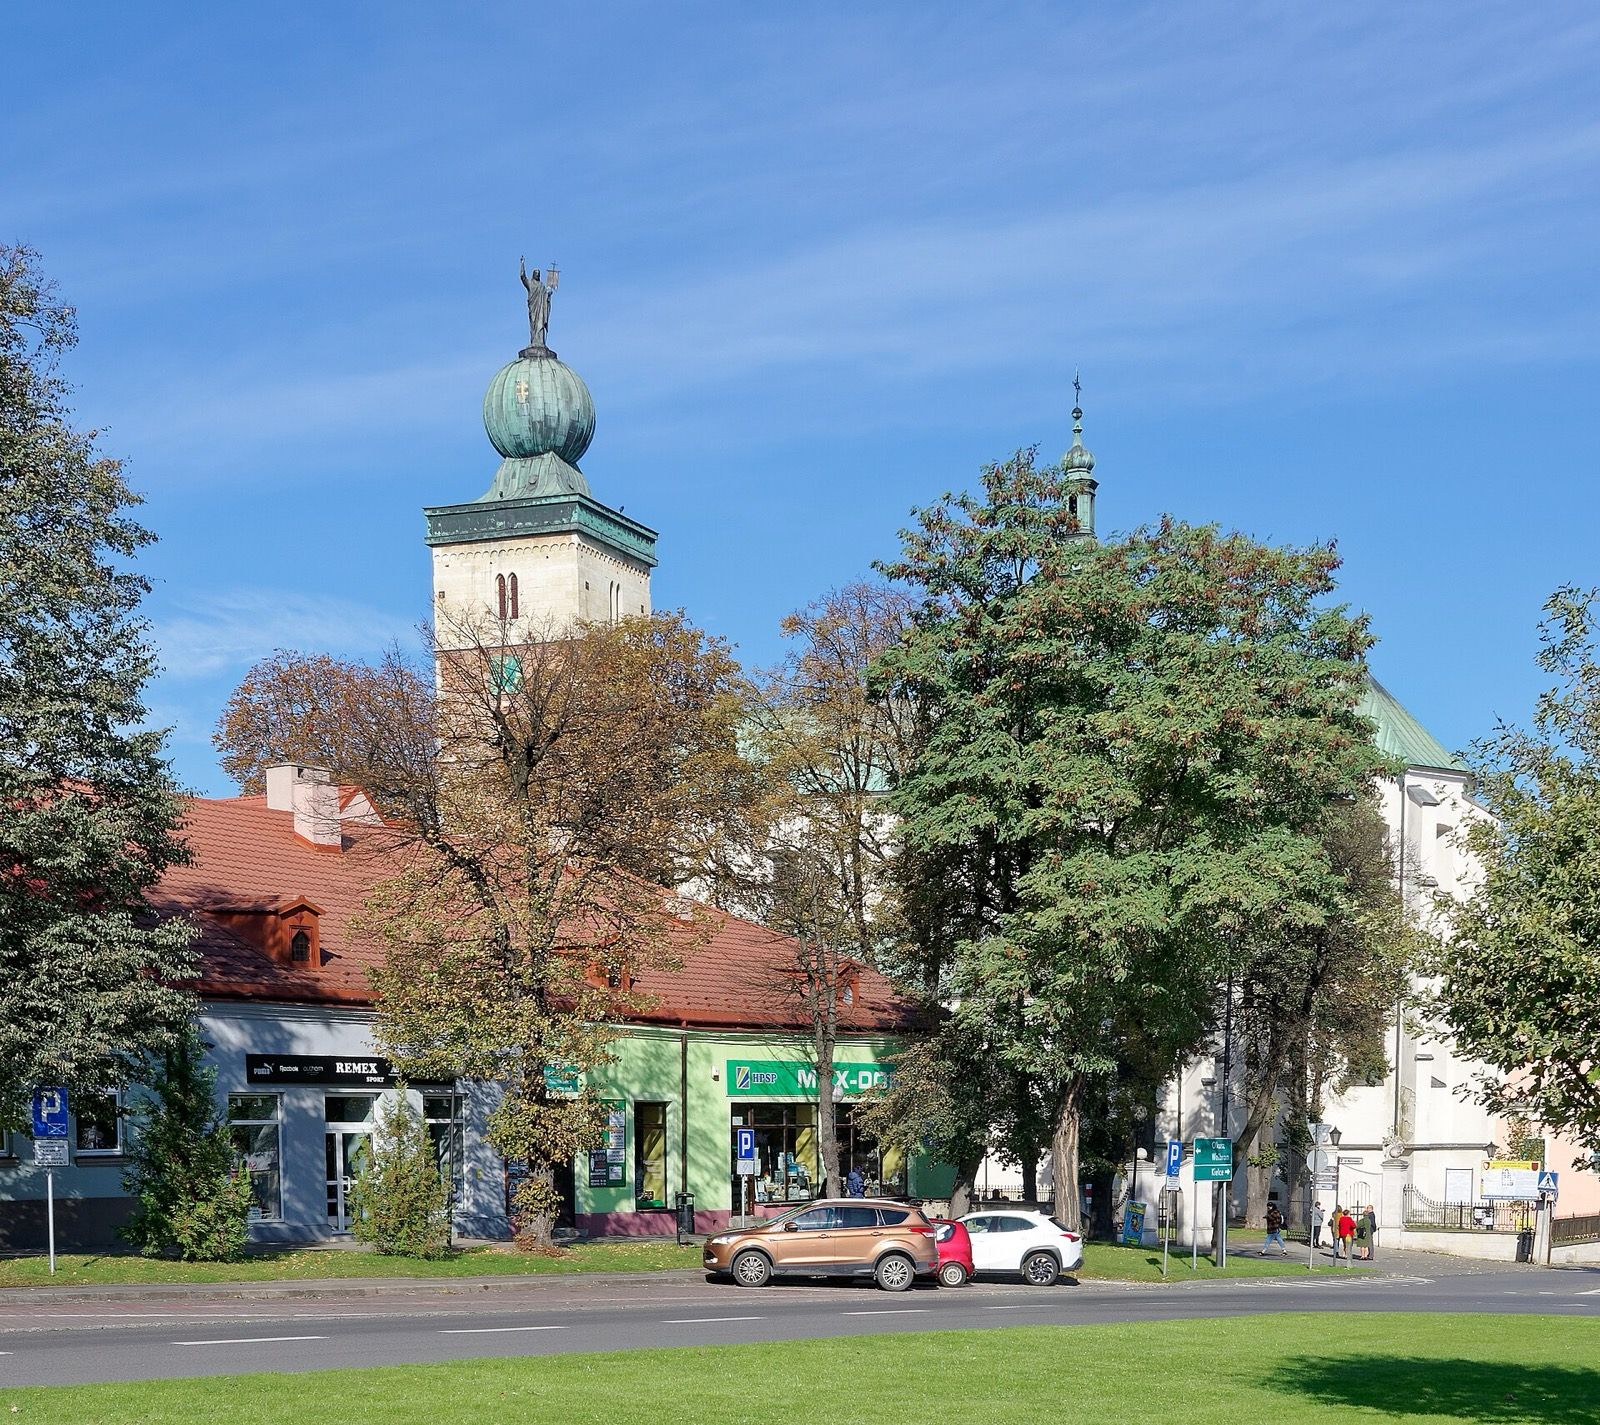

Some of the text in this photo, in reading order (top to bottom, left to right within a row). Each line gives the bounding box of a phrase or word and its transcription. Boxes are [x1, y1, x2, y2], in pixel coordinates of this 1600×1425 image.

[335, 1062, 378, 1074] REMEX
[752, 1072, 777, 1084] HPSP
[797, 1069, 904, 1090] MX-DO
[41, 1091, 61, 1123] P
[741, 1132, 751, 1157] P
[1170, 1144, 1179, 1166] P
